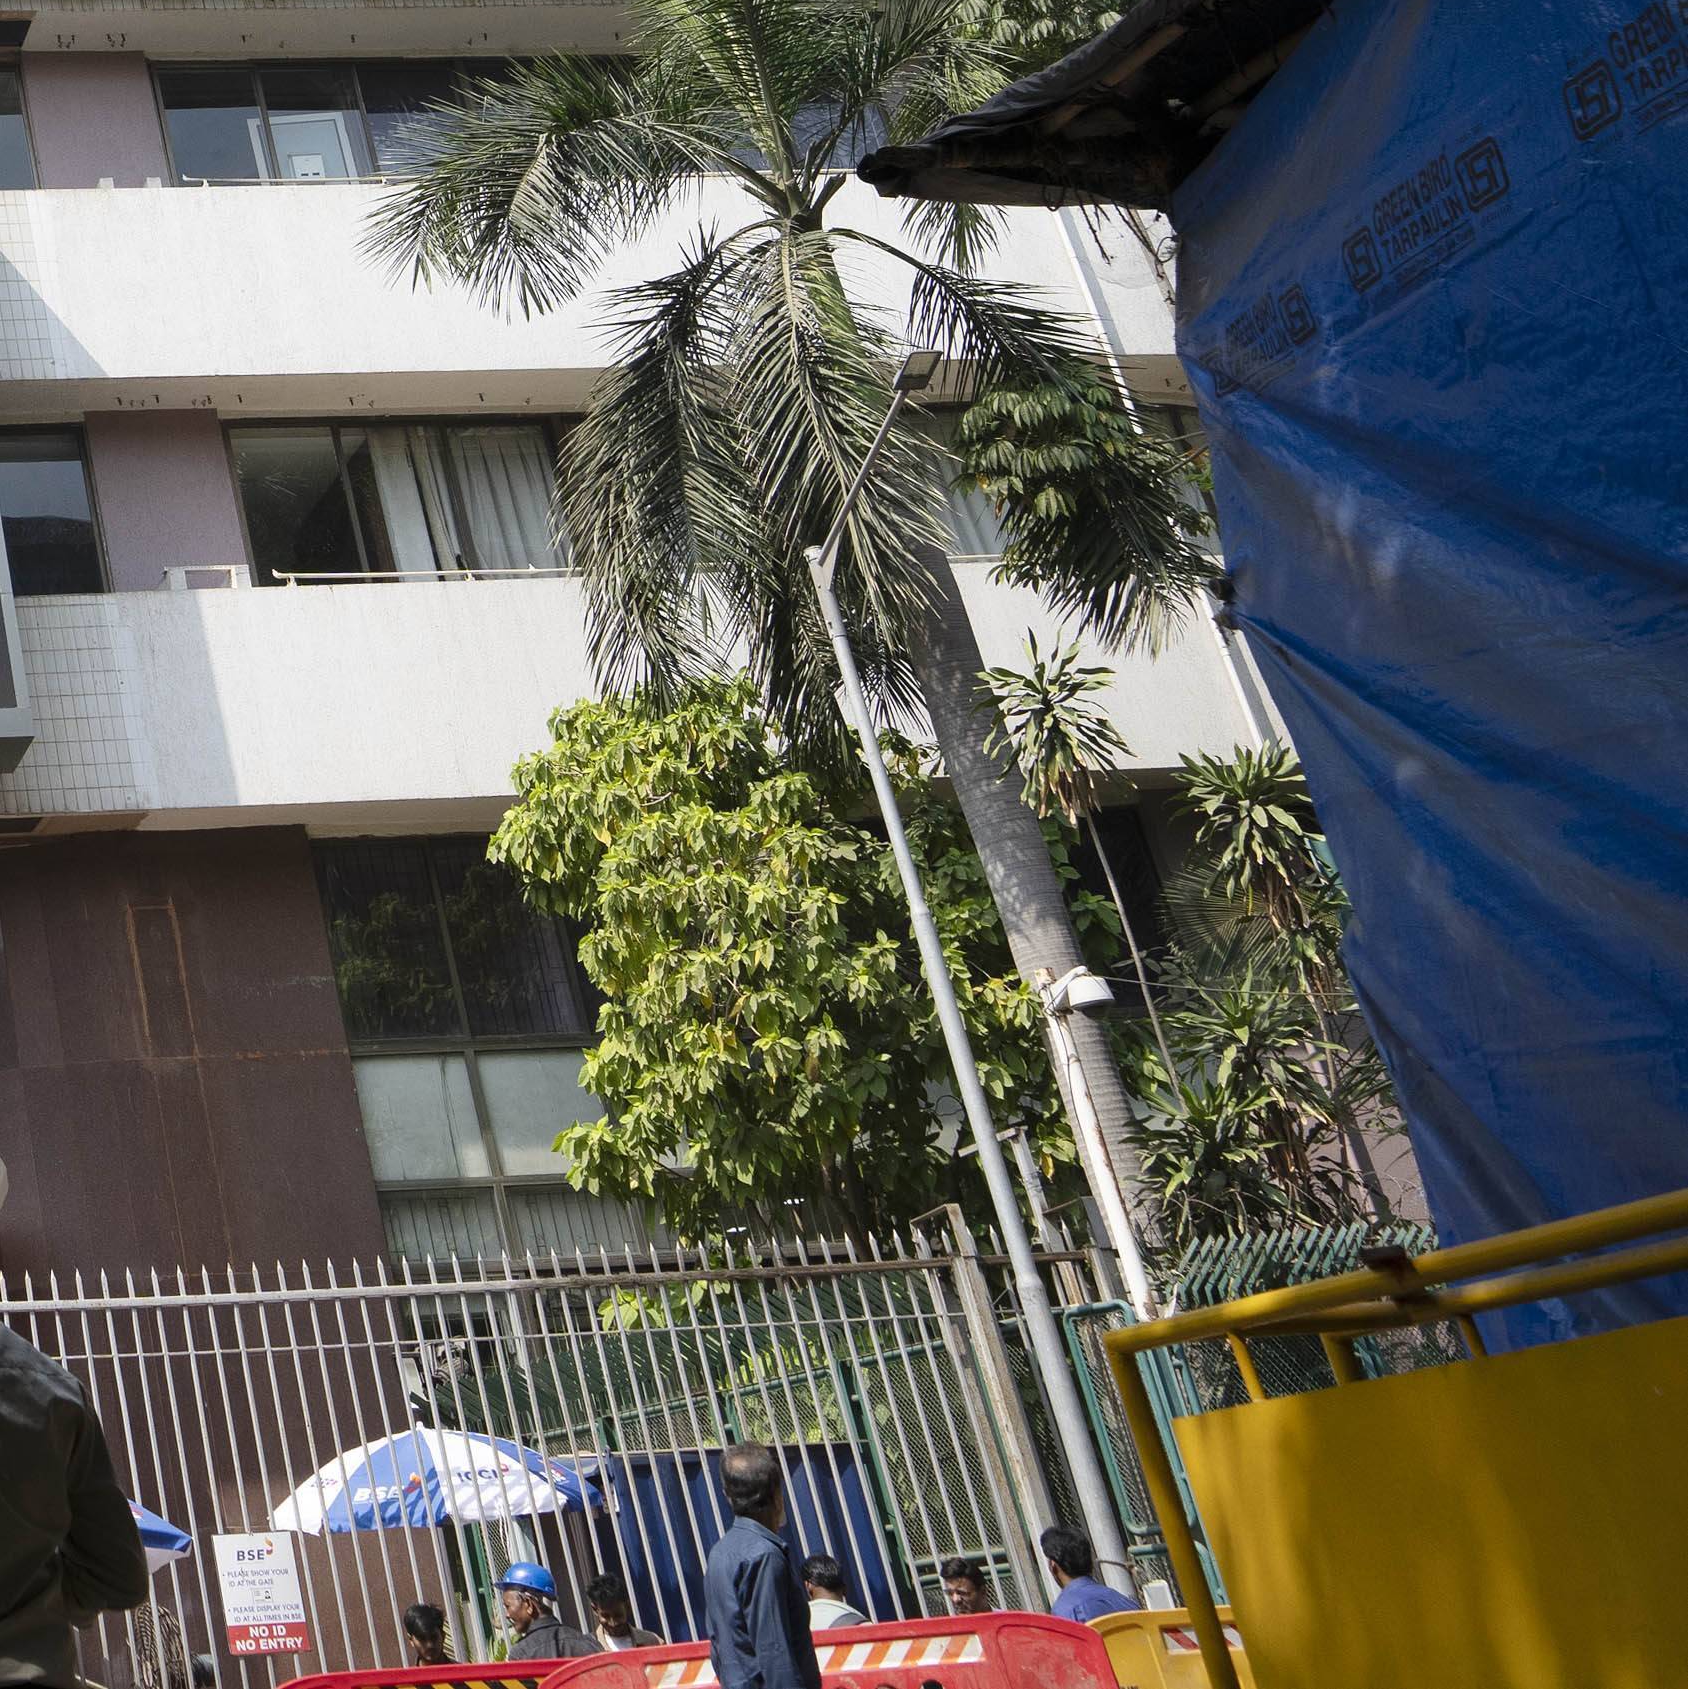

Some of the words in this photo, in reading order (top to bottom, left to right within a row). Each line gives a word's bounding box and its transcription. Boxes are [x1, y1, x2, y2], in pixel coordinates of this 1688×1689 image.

[1380, 192, 1465, 264] TARPAULIN
[236, 1549, 266, 1562] BSE
[251, 1569, 270, 1577] SHOW
[271, 1568, 289, 1576] YOUR
[256, 1604, 281, 1612] DISPLAY
[283, 1603, 300, 1611] YOUR
[248, 1626, 270, 1638] NO
[273, 1625, 287, 1637] ID
[235, 1639, 256, 1651] NO
[259, 1637, 303, 1650] ENTRY
